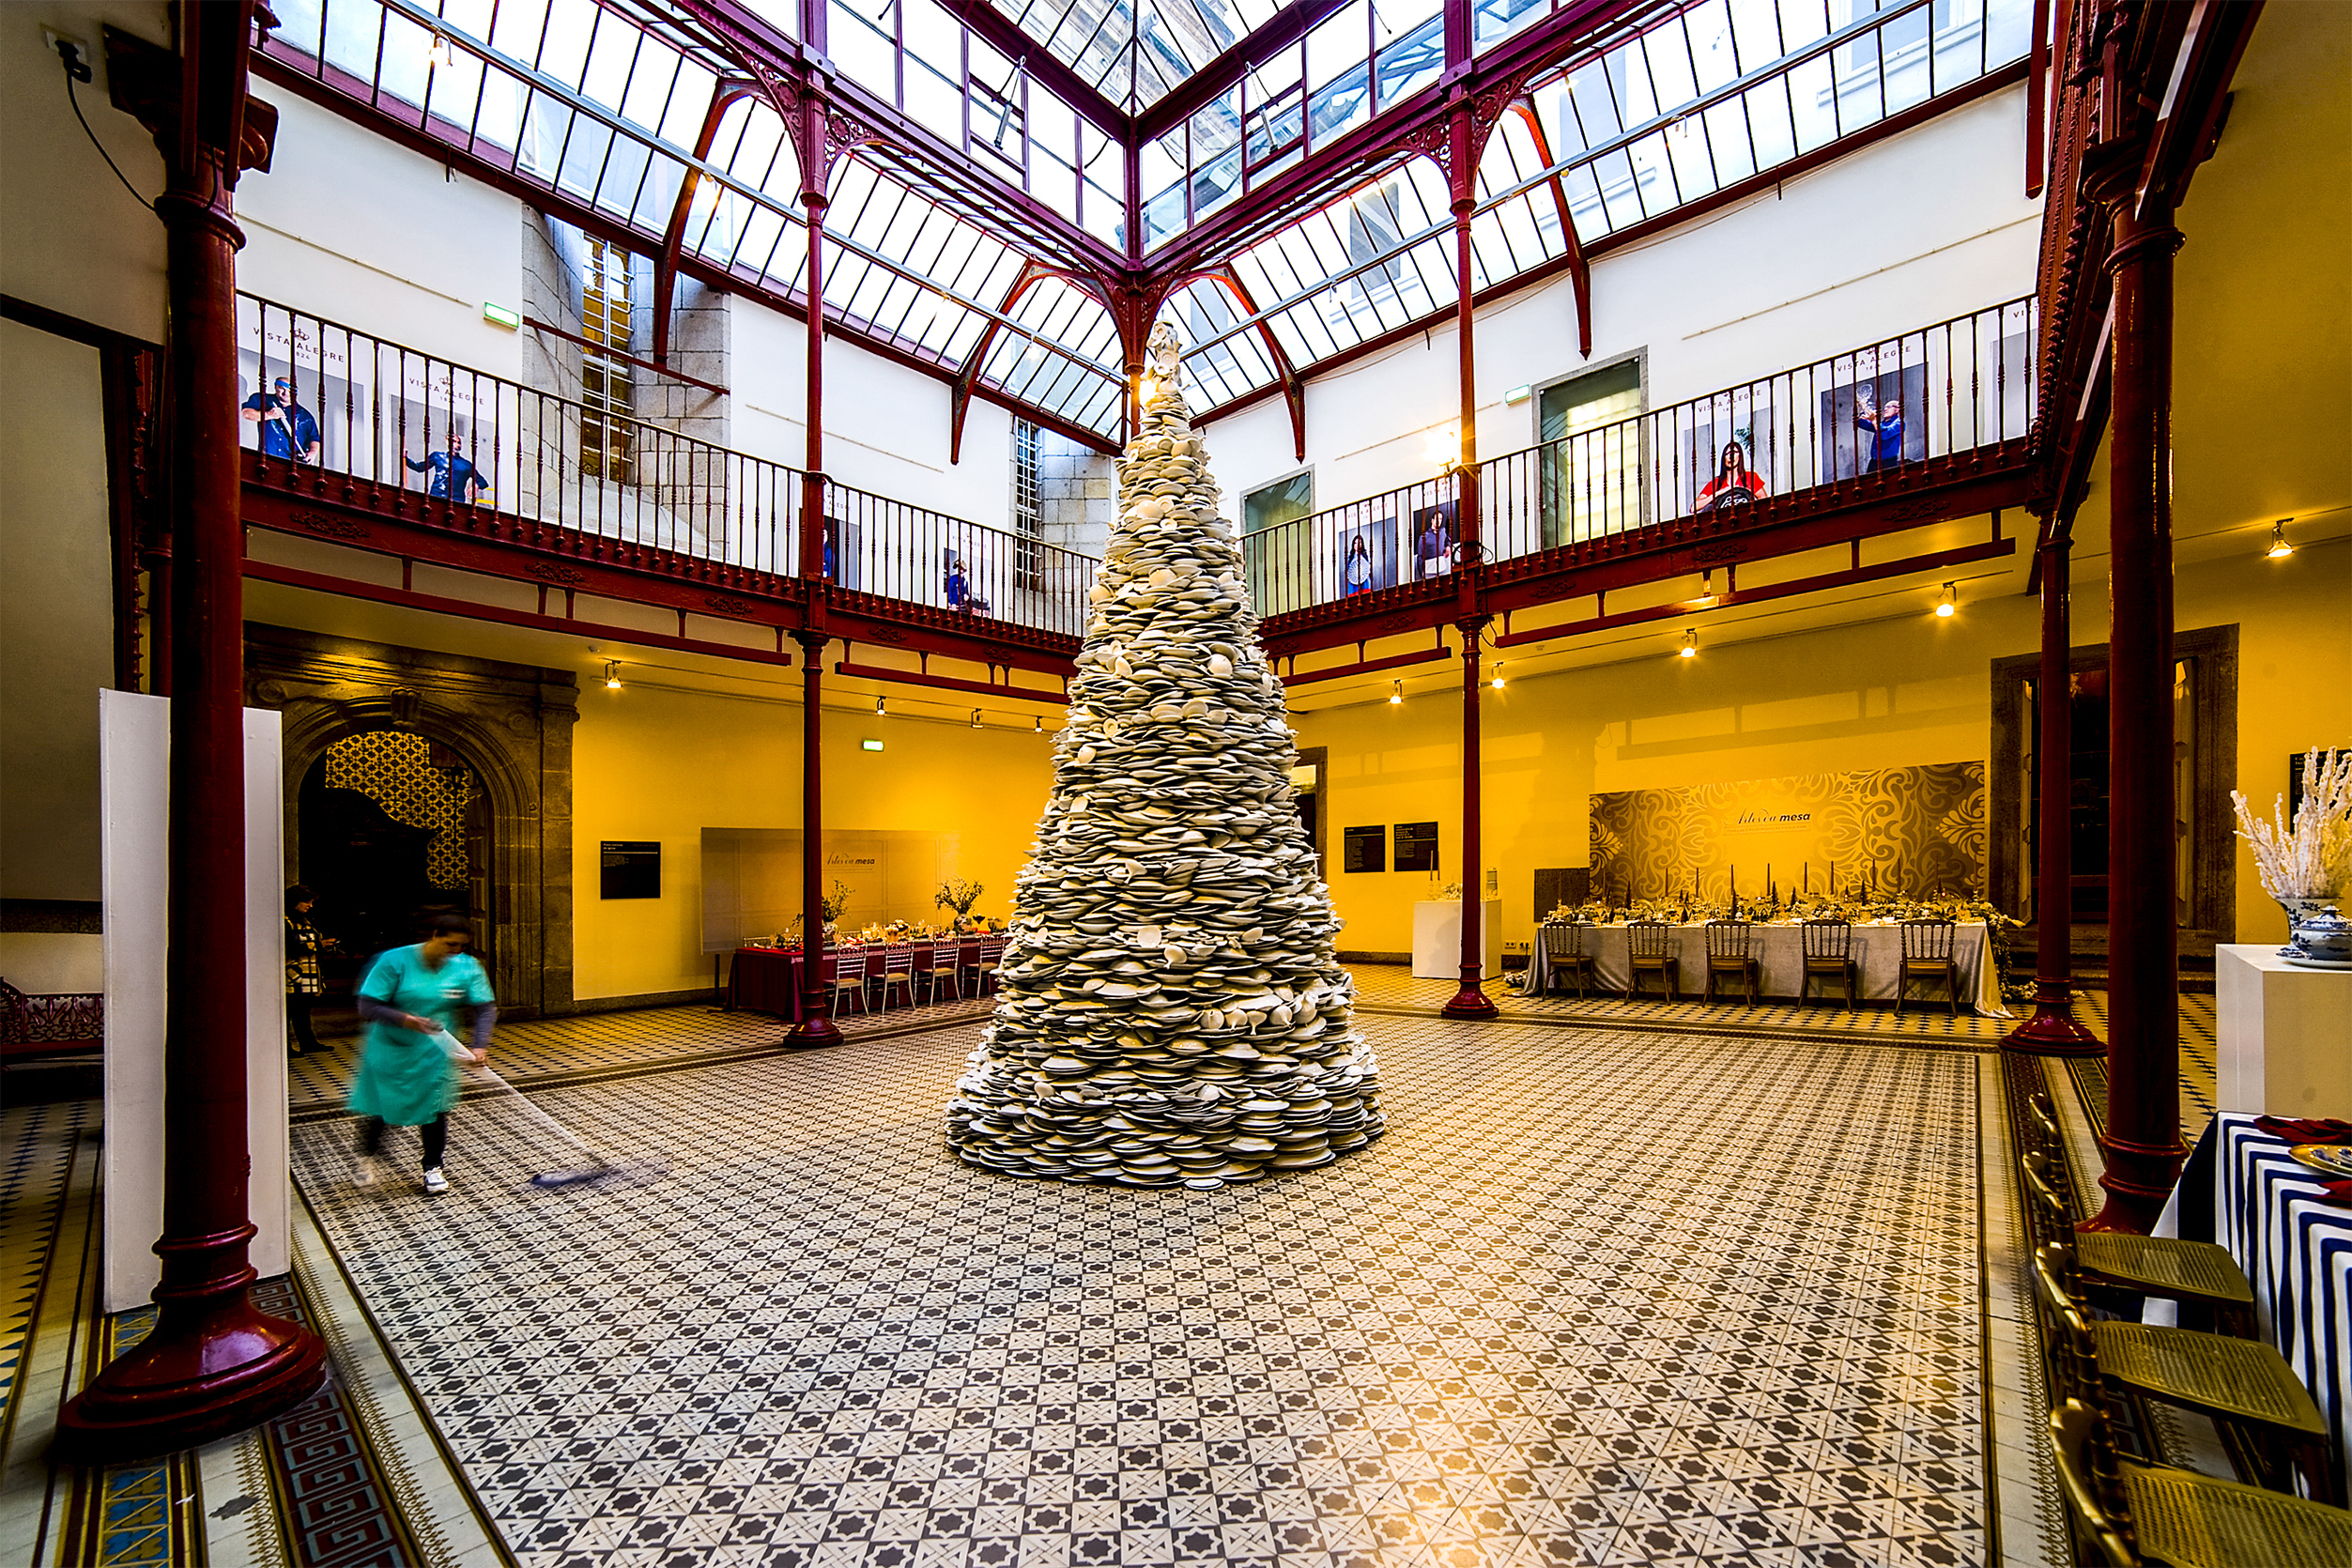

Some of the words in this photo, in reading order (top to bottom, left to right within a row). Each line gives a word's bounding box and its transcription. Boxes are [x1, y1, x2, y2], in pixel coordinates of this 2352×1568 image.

[253, 327, 290, 346] VSTA
[1869, 346, 1912, 363] AEGE
[444, 389, 485, 406] AEGE
[1778, 812, 1811, 823] mesa
